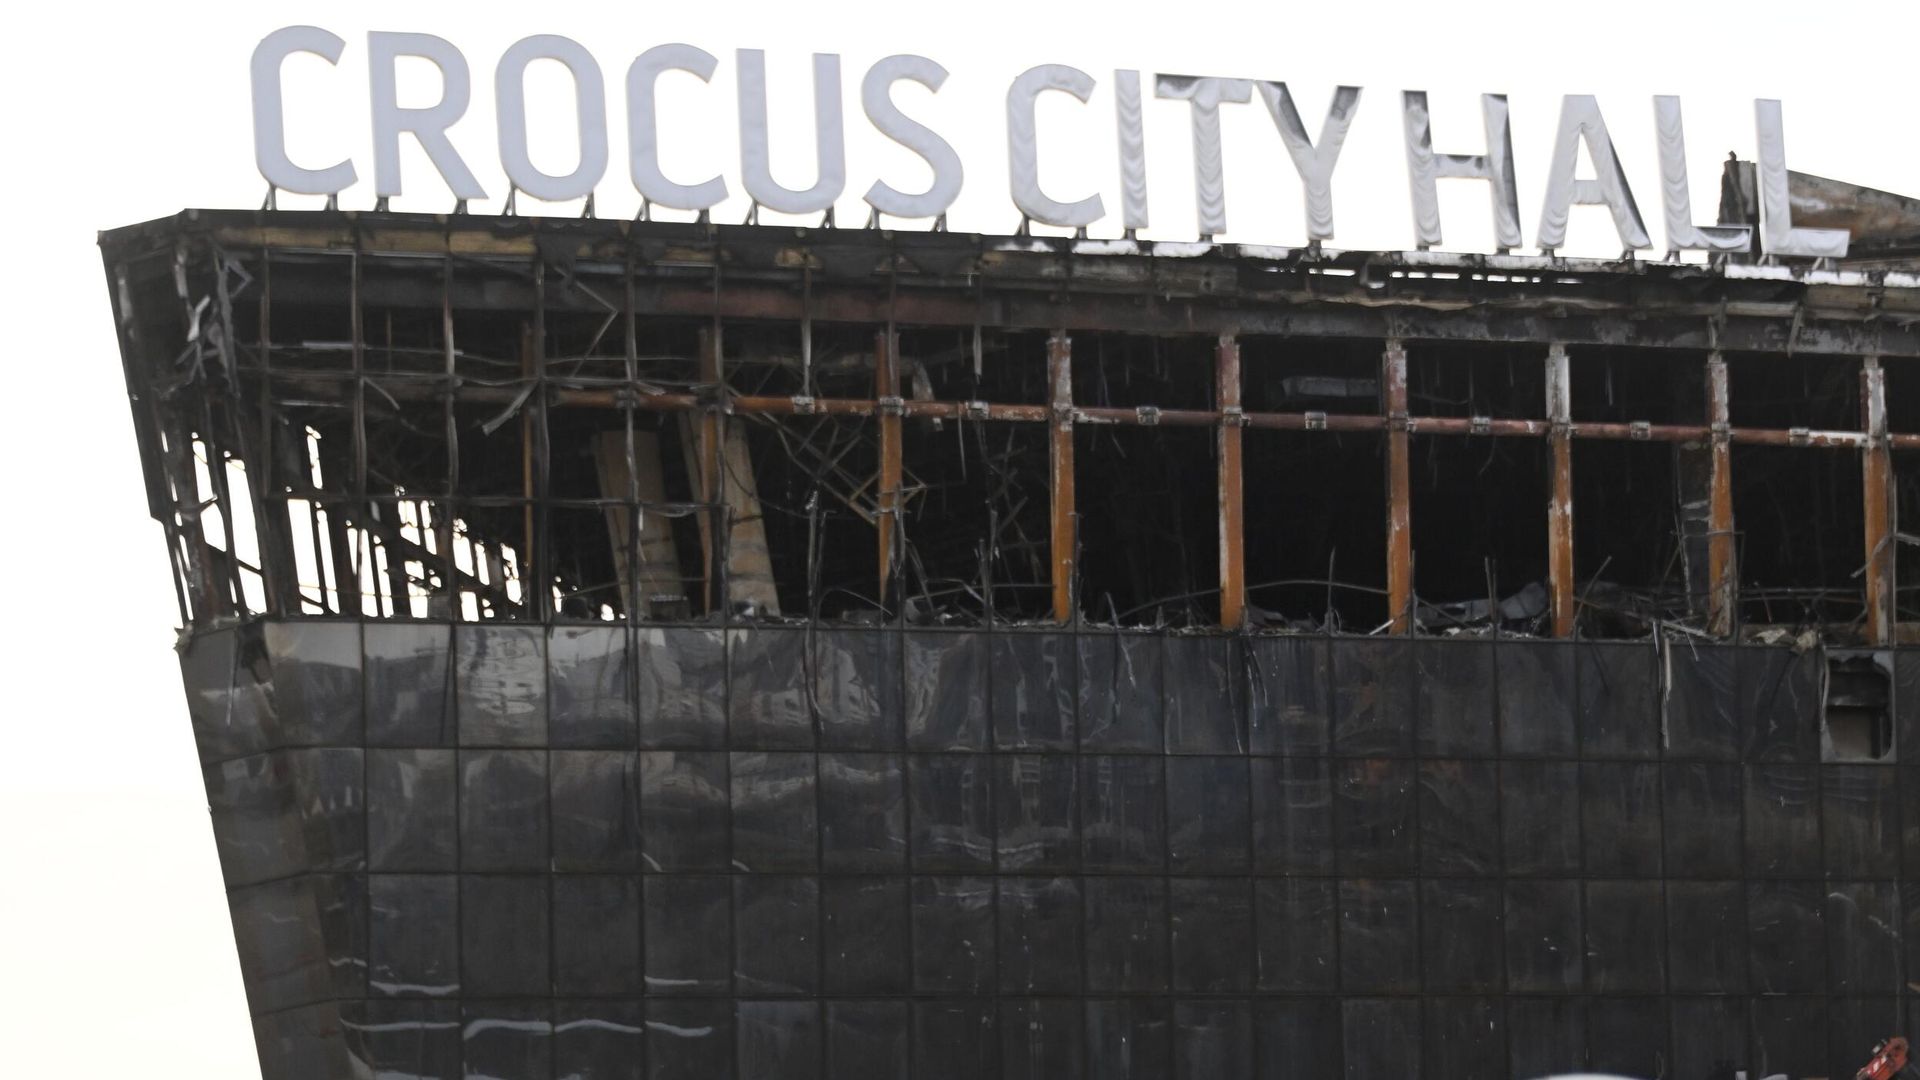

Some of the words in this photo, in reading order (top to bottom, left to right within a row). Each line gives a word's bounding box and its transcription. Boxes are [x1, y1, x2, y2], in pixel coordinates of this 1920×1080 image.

[250, 25, 964, 218] CROCUS
[1006, 63, 1364, 241] CITY
[1401, 89, 1851, 258] HALL
